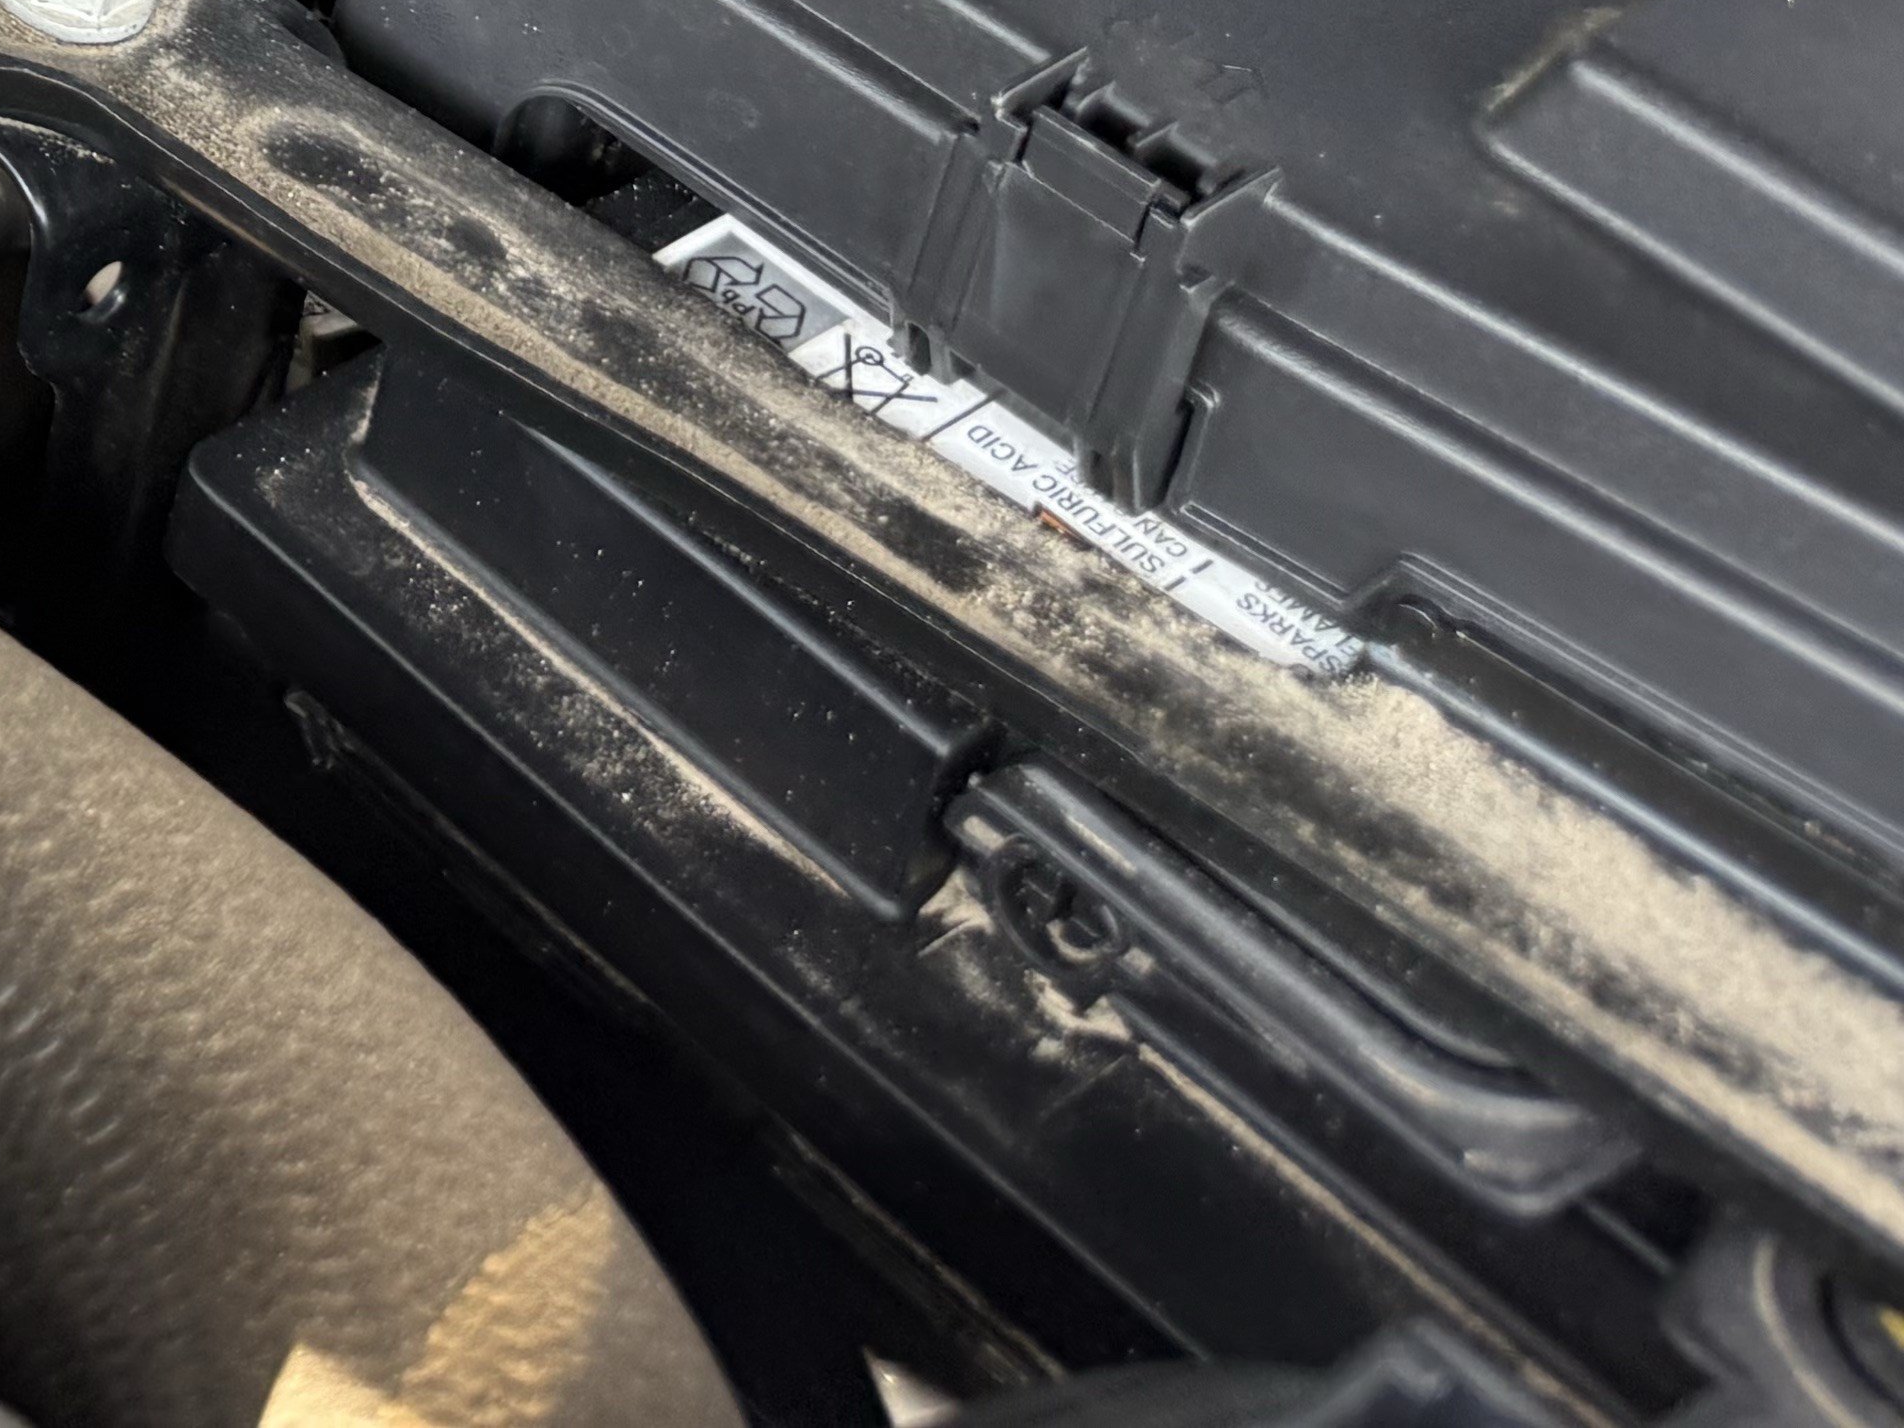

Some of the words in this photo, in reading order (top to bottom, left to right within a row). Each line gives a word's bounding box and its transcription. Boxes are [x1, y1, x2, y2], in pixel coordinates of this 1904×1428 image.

[723, 287, 766, 321] Pb
[966, 423, 1039, 474] ACID
[1031, 473, 1166, 575] SULFURIC
[1132, 518, 1189, 559] CAN
[1236, 591, 1344, 674] SPARKS
